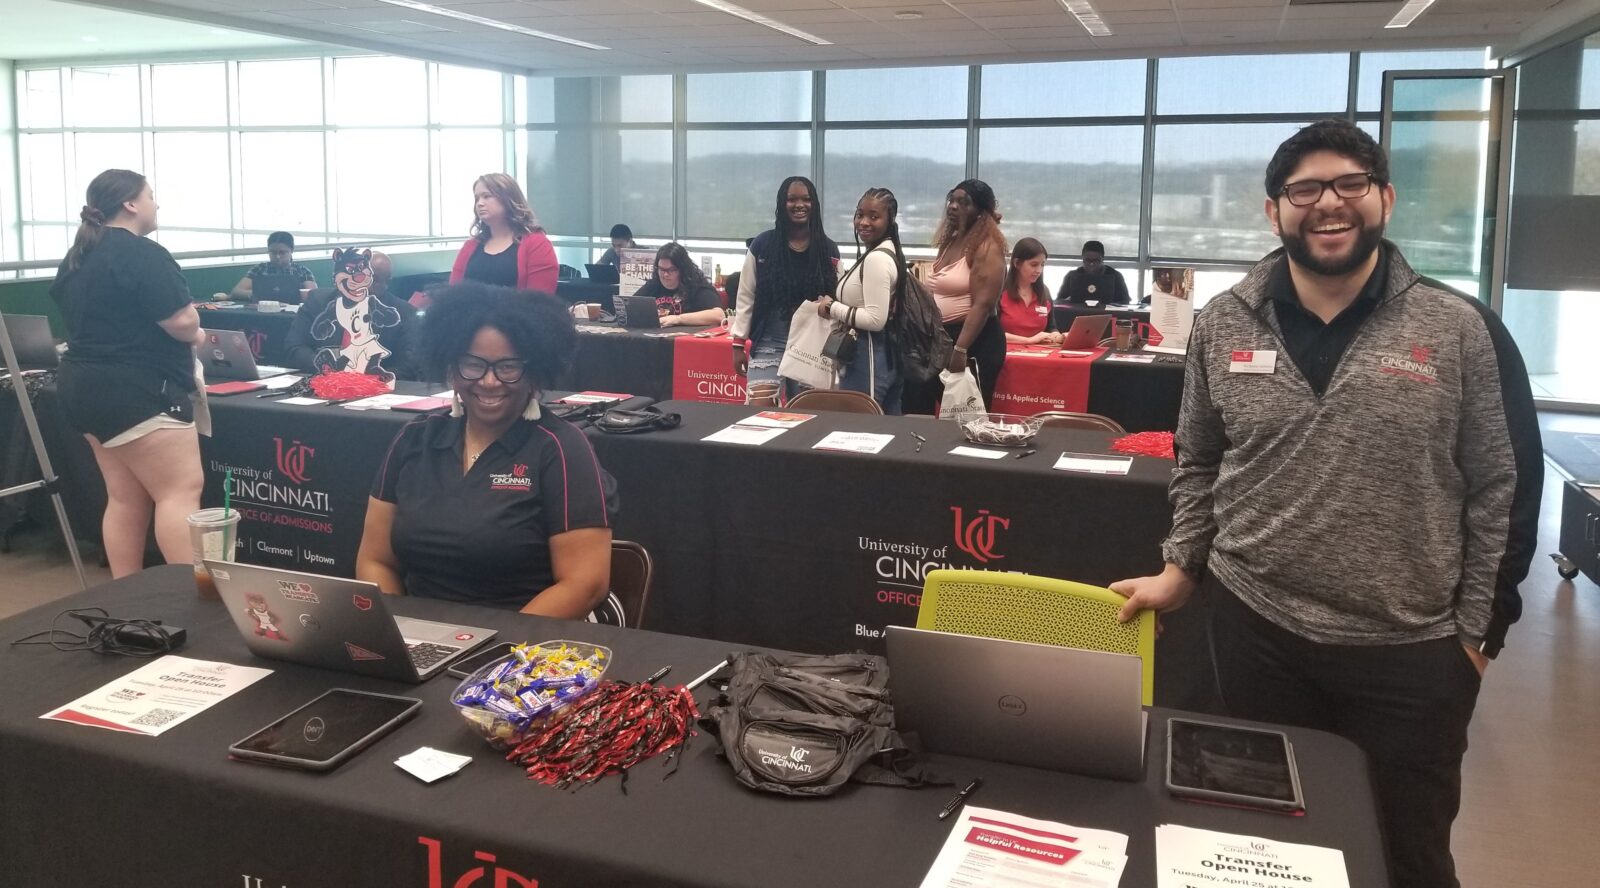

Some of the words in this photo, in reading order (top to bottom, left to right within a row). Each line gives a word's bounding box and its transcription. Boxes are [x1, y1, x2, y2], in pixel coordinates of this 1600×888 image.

[625, 263, 636, 271] BE
[637, 263, 653, 272] THE
[687, 369, 729, 383] University
[697, 380, 747, 398] CINCIN
[1013, 394, 1039, 403] Applied
[1039, 396, 1065, 405] Science
[210, 460, 261, 480] University
[262, 469, 273, 480] of
[223, 477, 330, 512] CINCINNATI
[273, 514, 333, 534] ADMISSIONS
[256, 540, 293, 557] Clermont
[303, 549, 335, 565] Uptown
[859, 536, 929, 560] University
[932, 545, 948, 559] of
[855, 624, 880, 638] Blue
[159, 675, 190, 684] Open
[190, 680, 227, 689] House
[177, 671, 225, 682] Transfer
[761, 755, 811, 773] CINCINNATI
[976, 834, 1012, 848] Helpful
[1013, 843, 1065, 860] Resources
[1201, 859, 1249, 874] Open
[1255, 867, 1313, 882] House
[1214, 853, 1293, 871] Transfer
[1171, 868, 1220, 882] Tuesday,
[1222, 877, 1249, 886] April
